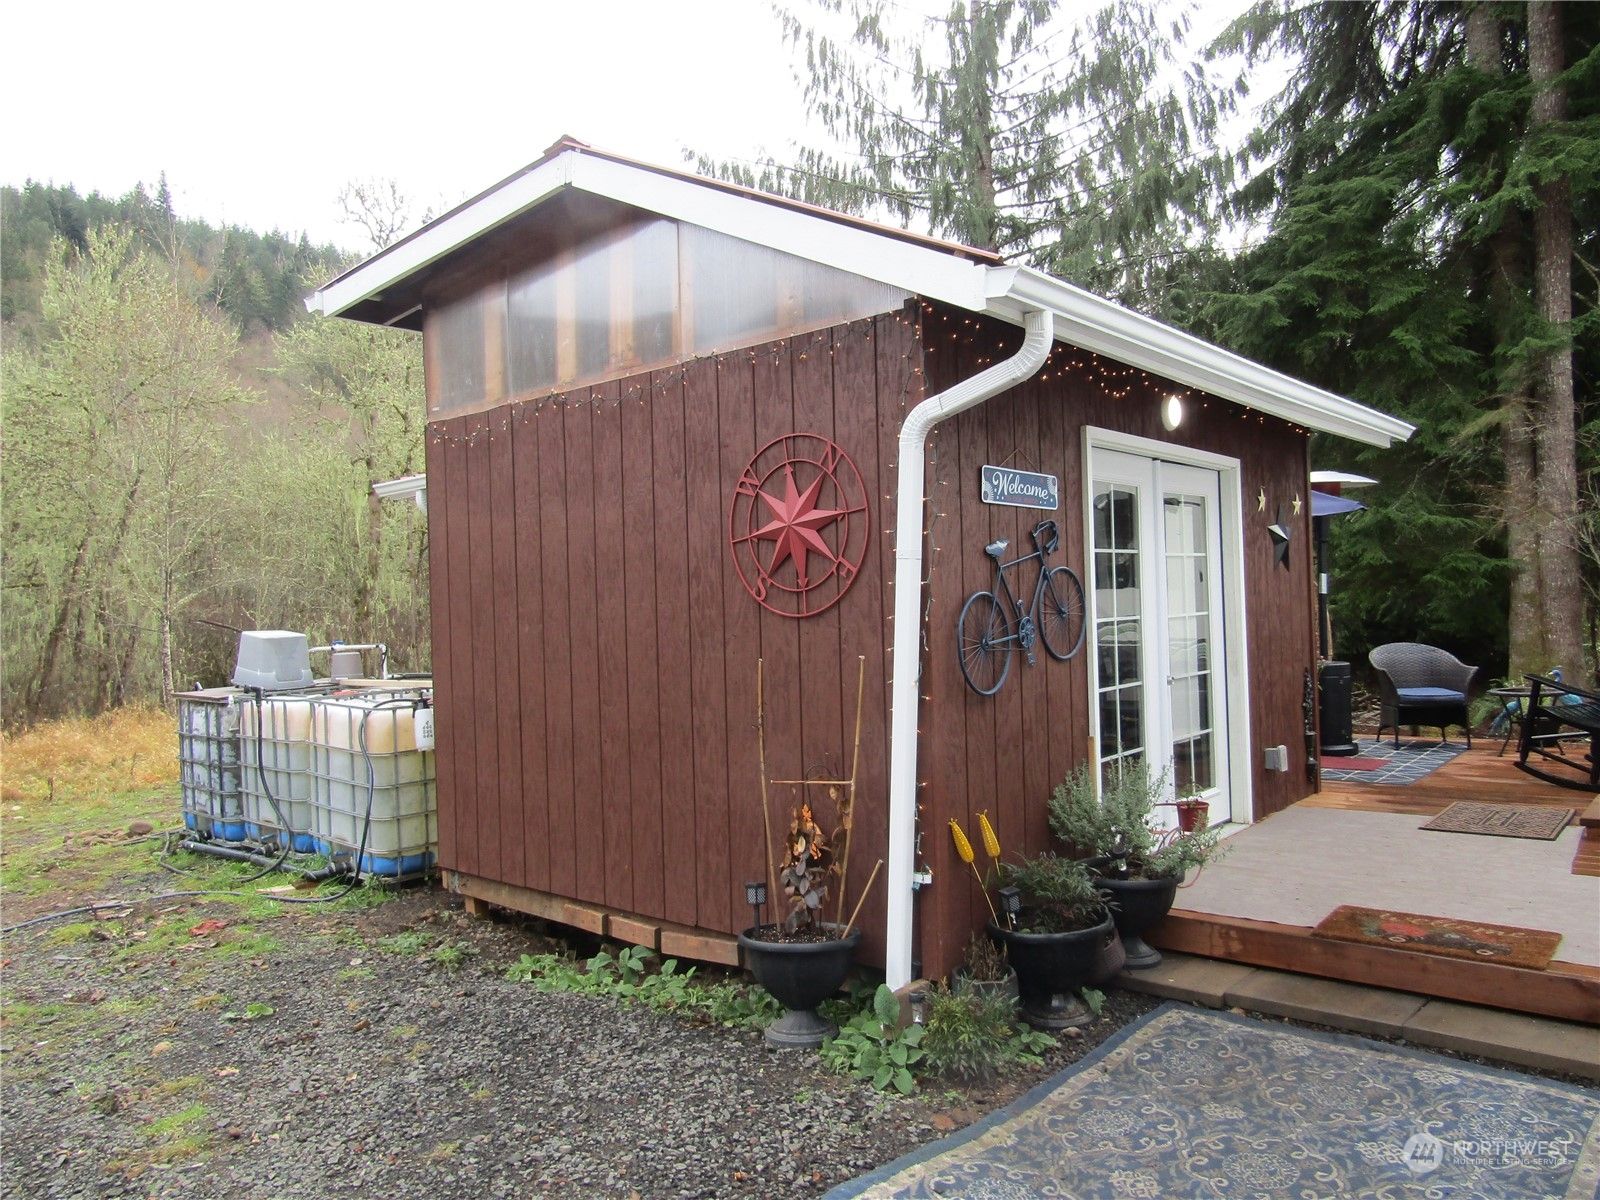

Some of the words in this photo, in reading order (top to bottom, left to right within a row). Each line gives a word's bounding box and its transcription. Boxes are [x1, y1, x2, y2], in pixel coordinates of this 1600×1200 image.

[819, 441, 845, 475] N
[992, 471, 1049, 500] Welcome
[832, 555, 858, 578] E
[752, 572, 773, 601] S
